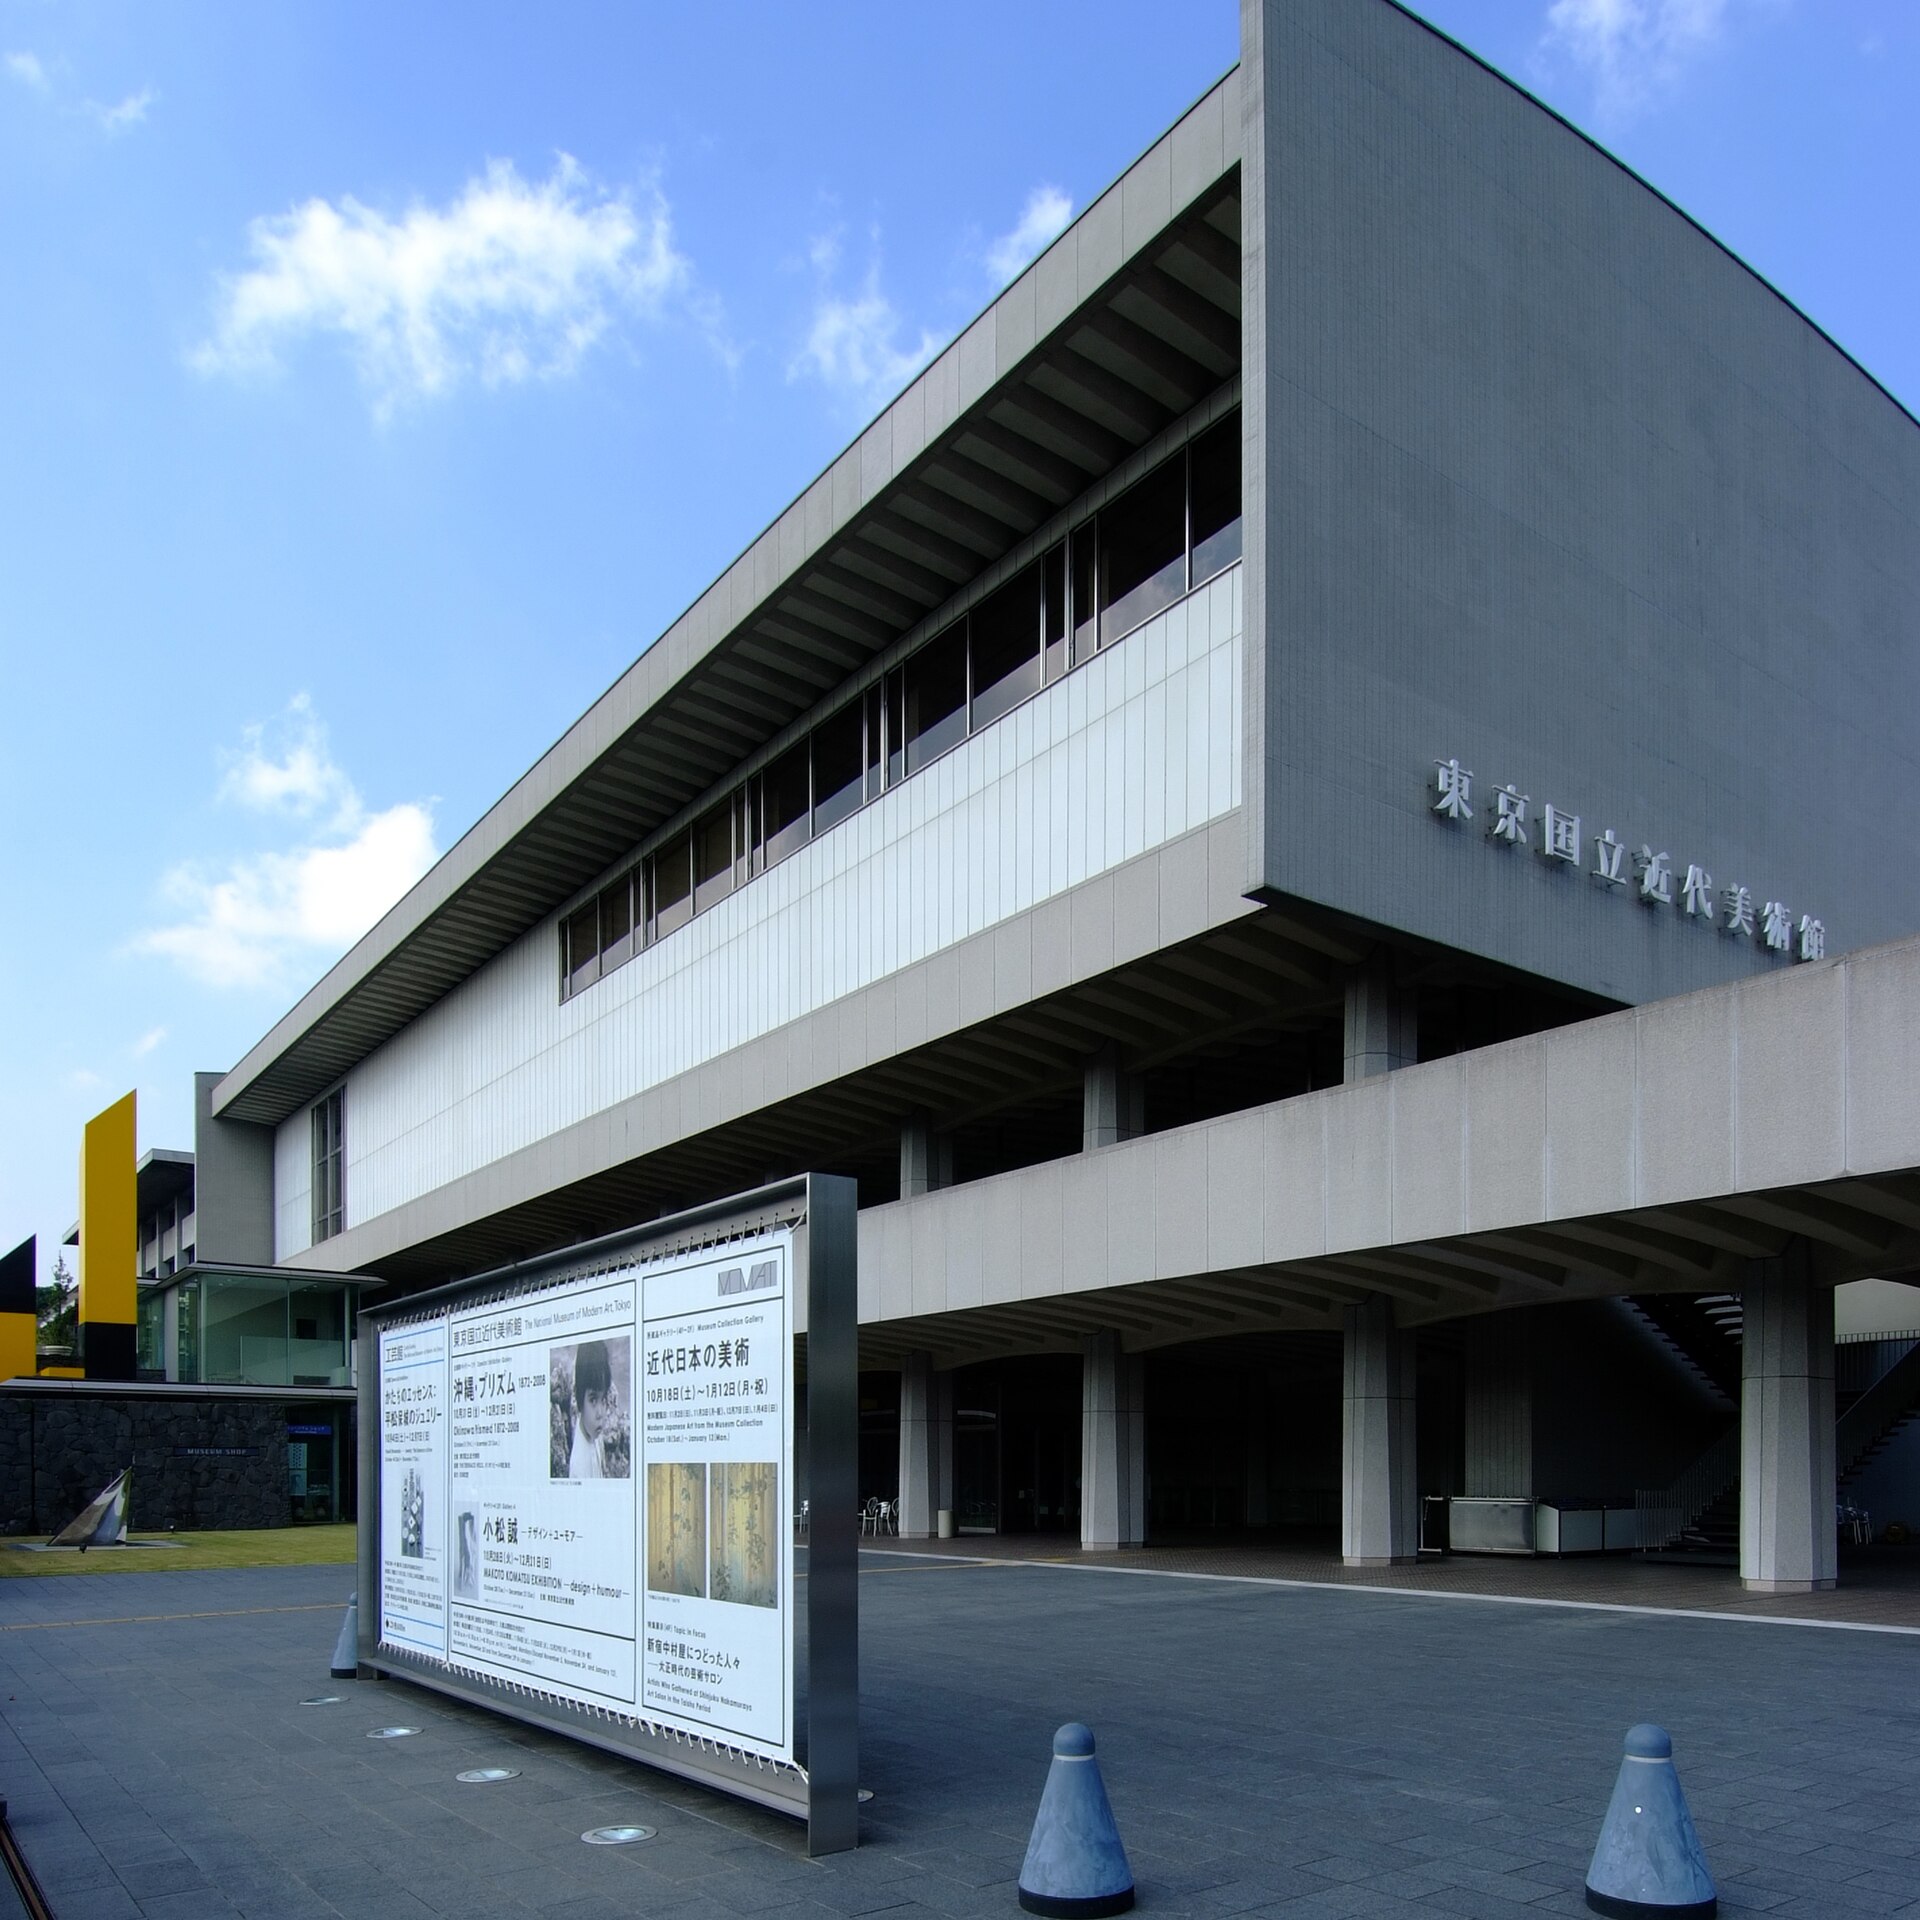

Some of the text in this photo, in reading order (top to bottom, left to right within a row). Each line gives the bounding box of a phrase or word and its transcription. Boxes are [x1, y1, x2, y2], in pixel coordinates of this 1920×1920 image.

[1433, 759, 1826, 960] 東京国立近代美術館
[453, 1317, 523, 1348] 東京国立近代美術館
[553, 1312, 575, 1324] Museum
[575, 1309, 582, 1318] of
[582, 1306, 603, 1318] Modern
[614, 1299, 631, 1311] Tokyo
[697, 1323, 716, 1332] Museum
[717, 1318, 743, 1328] Collection
[744, 1315, 764, 1325] Gallery
[647, 1337, 749, 1375] 近代日本の美術
[736, 1418, 763, 1427] Collection
[506, 1569, 531, 1585] KOMATSU
[531, 1574, 563, 1590] EXHIBITION
[647, 1637, 740, 1669] 新宿中村屋につどった人々
[671, 1683, 692, 1696] Gathered
[695, 1700, 711, 1713] Period
